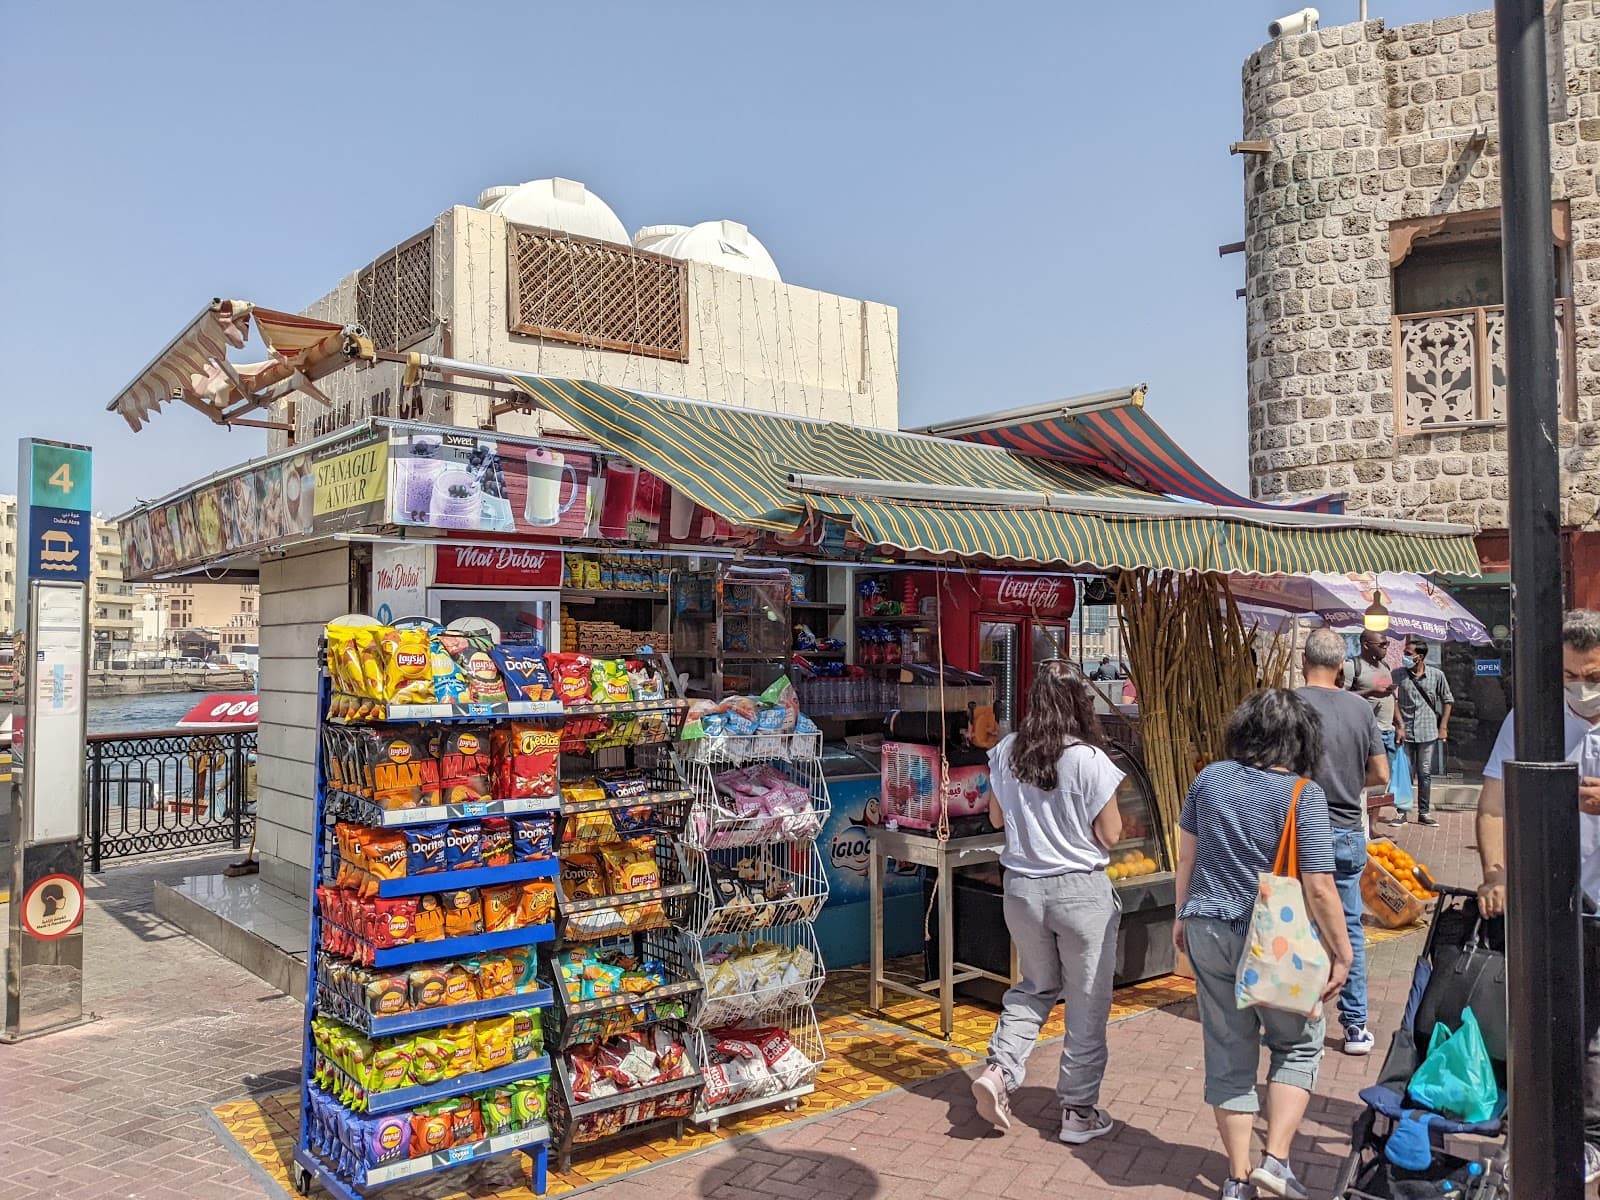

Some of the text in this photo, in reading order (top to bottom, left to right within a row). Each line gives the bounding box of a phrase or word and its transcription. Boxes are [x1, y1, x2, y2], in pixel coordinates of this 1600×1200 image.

[49, 463, 74, 494] 4
[317, 450, 377, 488] STANAGUL
[325, 478, 367, 510] ANWAR
[455, 547, 545, 569] Mai Dubai
[377, 563, 420, 592] Mai Dubai
[998, 575, 1060, 609] Coca-Cola
[399, 654, 416, 666] Lay's
[1477, 663, 1499, 671] OPEN
[522, 734, 559, 755] Cheetos
[374, 762, 422, 791] MAX
[564, 869, 598, 880] Doritos
